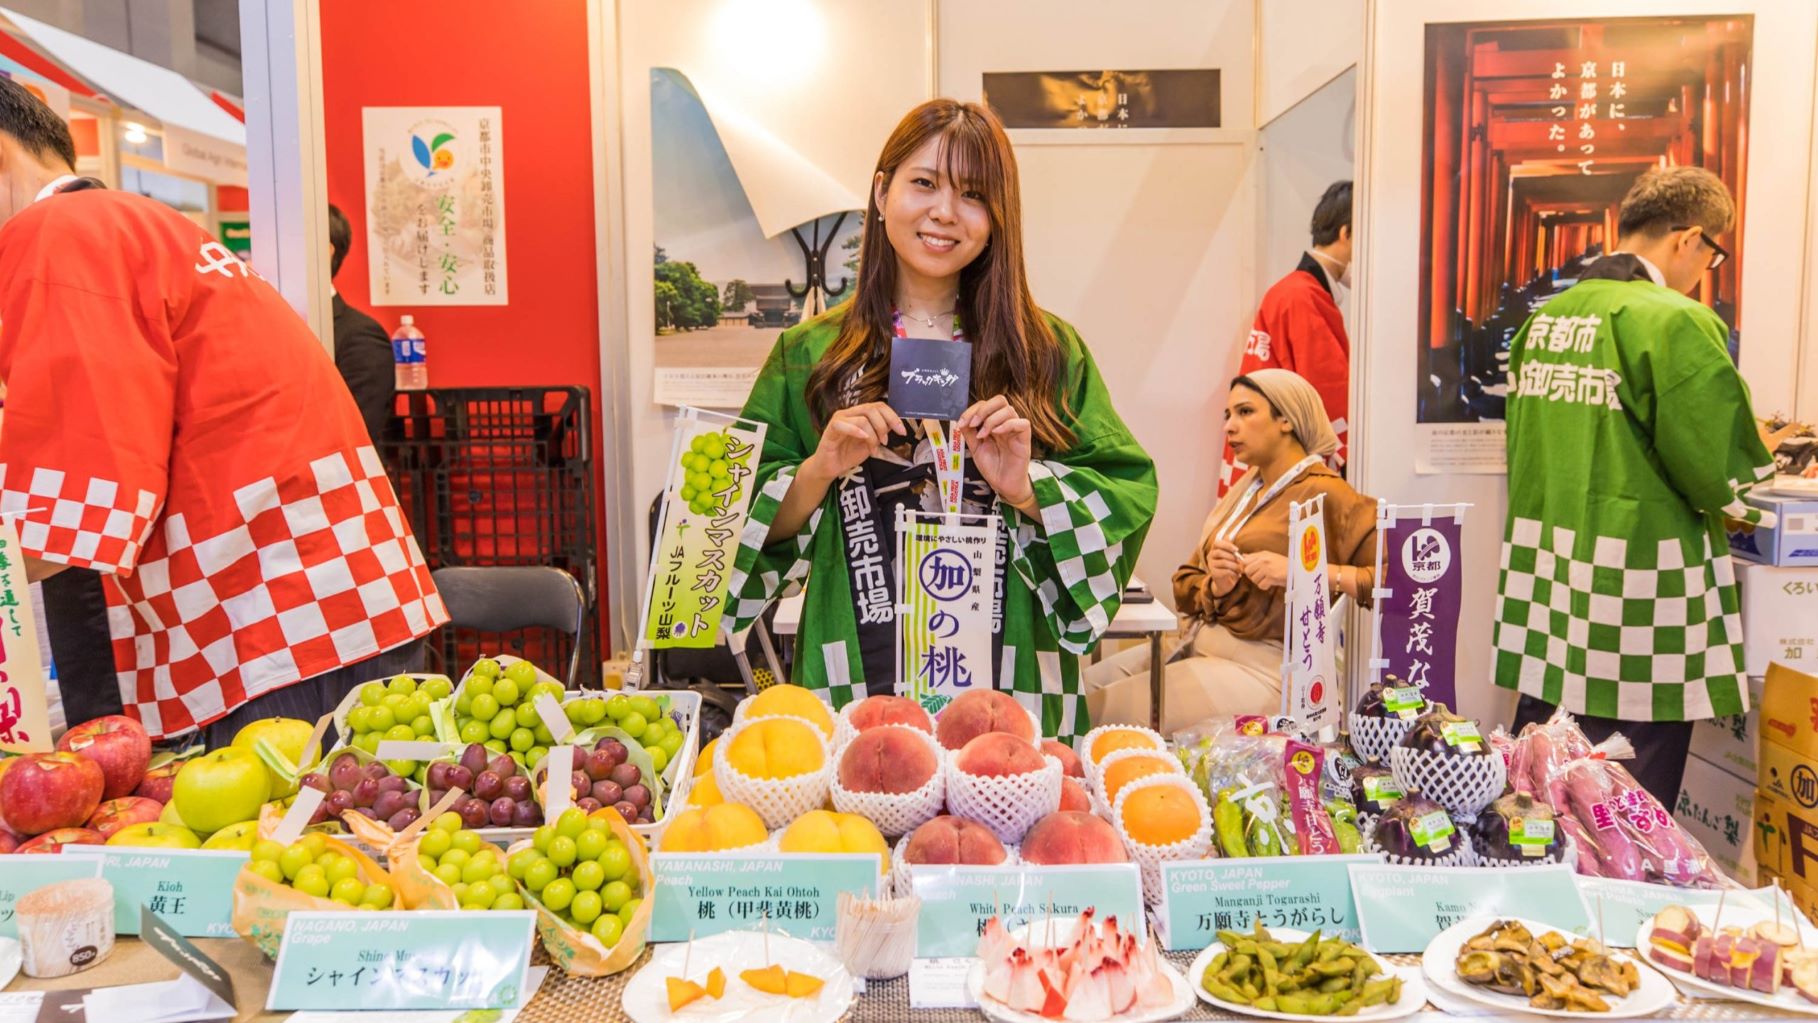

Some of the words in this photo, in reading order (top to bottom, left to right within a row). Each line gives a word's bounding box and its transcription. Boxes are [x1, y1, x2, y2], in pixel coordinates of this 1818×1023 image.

[1609, 61, 1627, 131] 日本に、
[1549, 62, 1568, 152] よかった。
[1578, 60, 1597, 175] 京都があって
[415, 203, 431, 296] をお届けします
[438, 194, 460, 296] 安全・安心
[1525, 313, 1602, 354] 京都市
[690, 437, 755, 639] シャインマスカット
[915, 534, 987, 545] 環境にやさしい桃作り
[1412, 561, 1441, 572] 京都
[971, 550, 983, 612] 山梨県産
[1406, 587, 1438, 710] 賀茂な
[125, 856, 171, 868] JAPAN
[656, 860, 736, 873] YAMANASHI,
[739, 860, 784, 873] JAPAN
[655, 874, 693, 886] Peach
[1170, 869, 1217, 882] KYOTO,
[1220, 867, 1263, 879] JAPAN
[1409, 873, 1449, 886] JAPAN
[157, 880, 183, 893] Kioh
[688, 886, 724, 898] Yellow
[728, 886, 760, 898] Peach
[765, 886, 782, 898] Kai
[787, 886, 820, 898] Ohtoh
[1171, 882, 1207, 893] Green
[1211, 880, 1245, 892] Sweet
[1249, 879, 1291, 891] Pepper
[150, 895, 187, 915] 黄王
[1215, 895, 1263, 908] Manganji
[1267, 892, 1321, 905] Togarashi
[970, 903, 997, 915] White
[1436, 902, 1466, 913] Kamo
[1196, 906, 1345, 931] 万願寺とうがらし
[293, 919, 358, 933] NAGANO,
[361, 920, 410, 932] JAPAN
[291, 933, 331, 946] Grape
